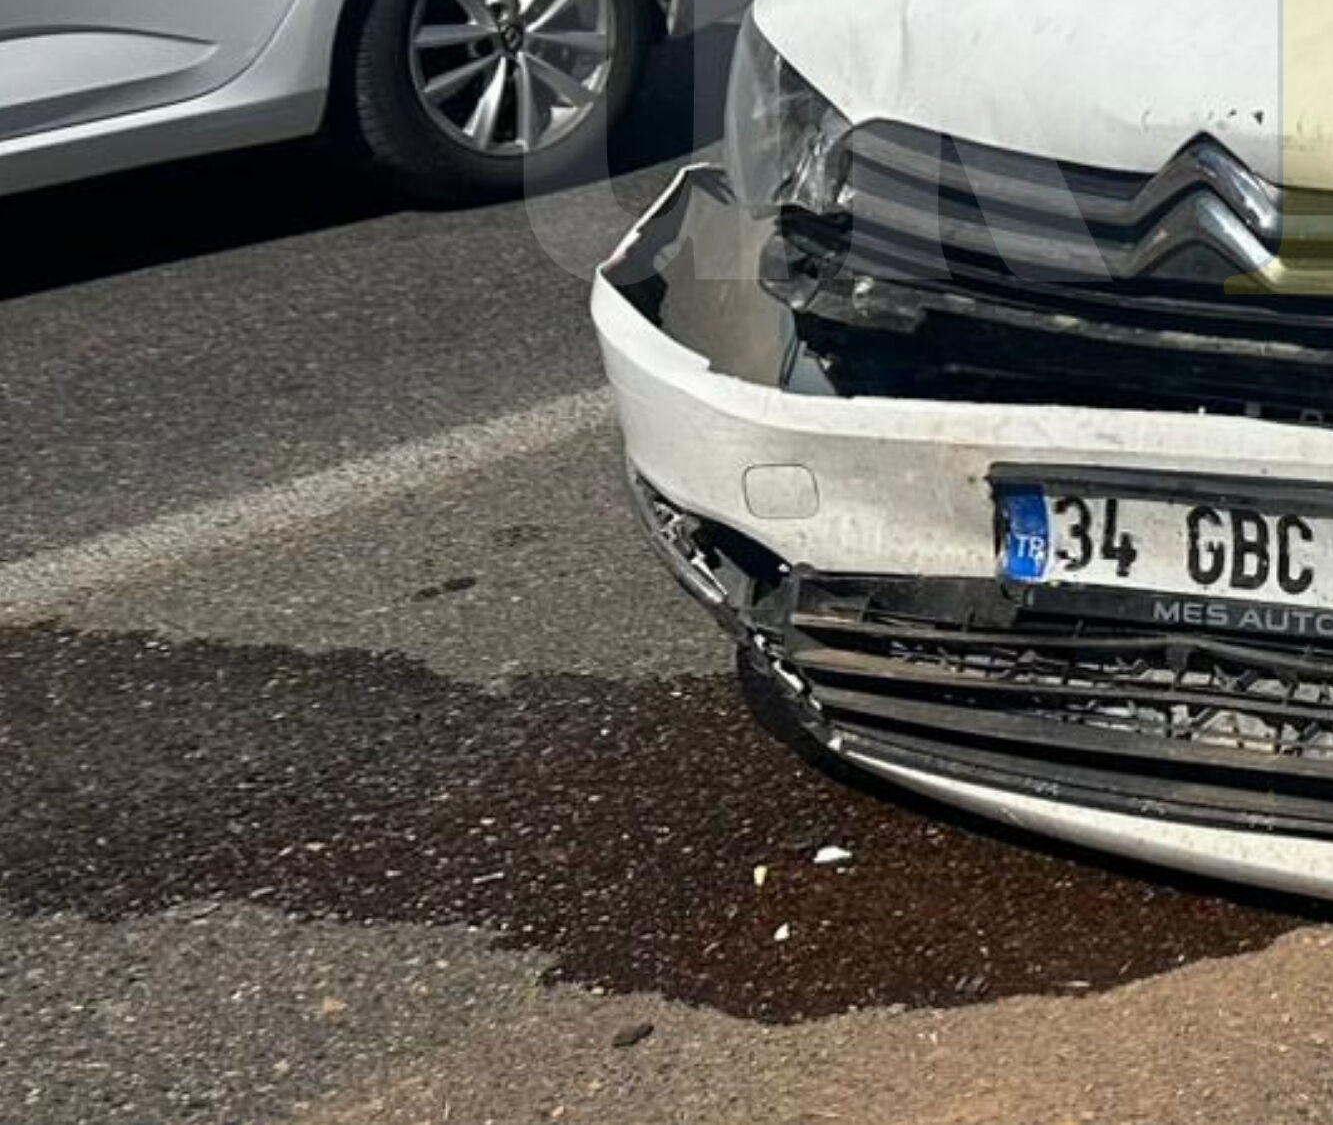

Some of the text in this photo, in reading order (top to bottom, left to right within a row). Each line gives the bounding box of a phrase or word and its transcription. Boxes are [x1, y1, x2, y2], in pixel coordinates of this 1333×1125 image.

[1054, 495, 1138, 578] 34
[1186, 505, 1314, 596] GBC
[1153, 601, 1231, 627] MES
